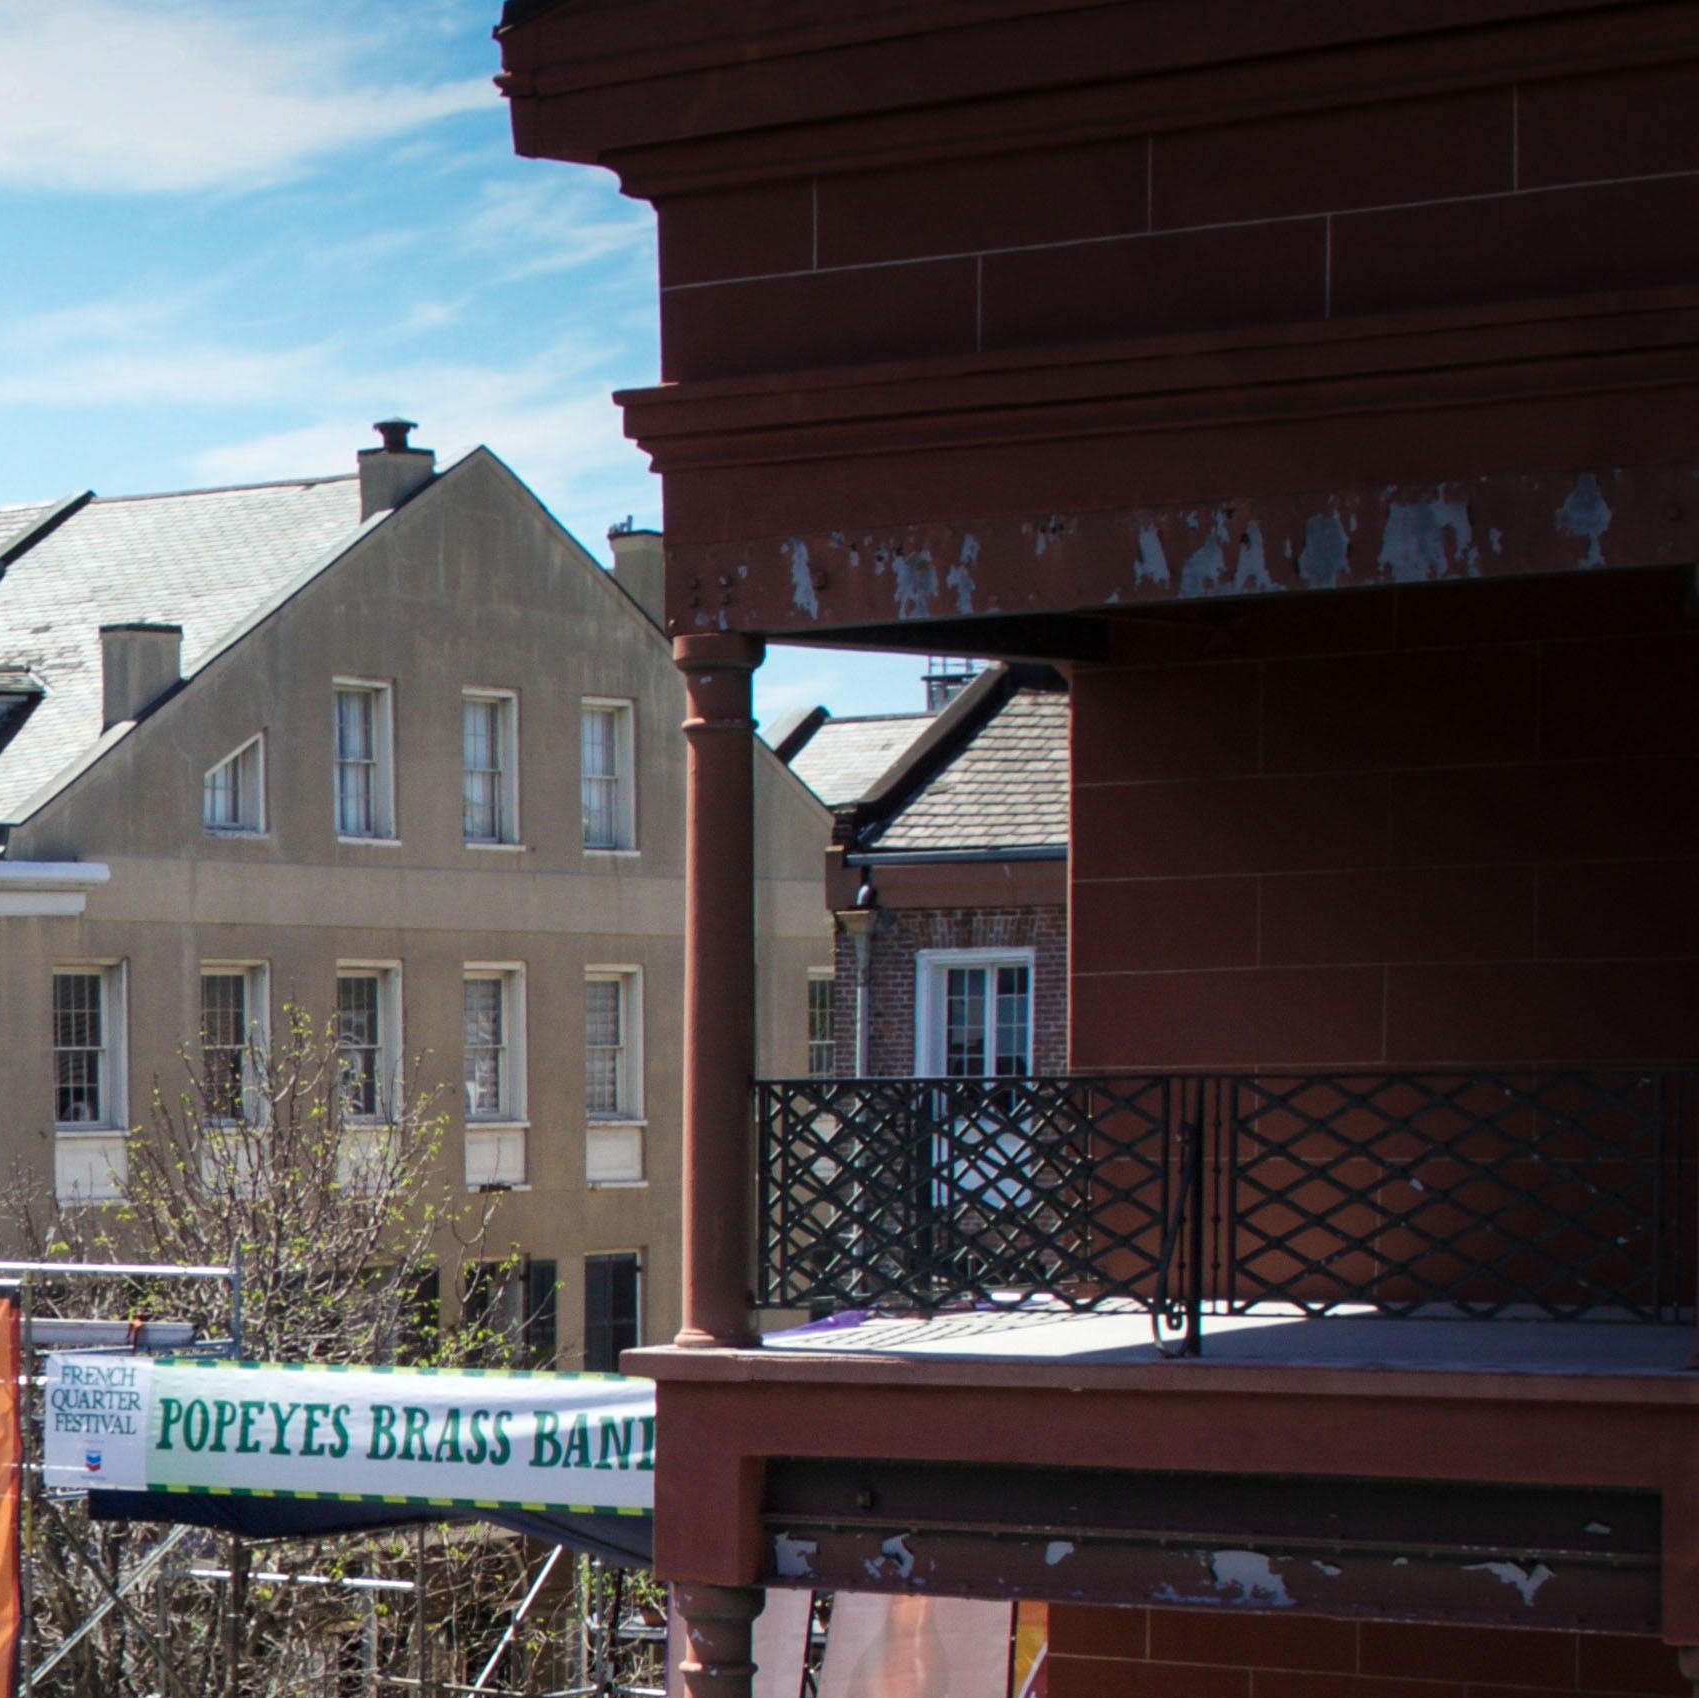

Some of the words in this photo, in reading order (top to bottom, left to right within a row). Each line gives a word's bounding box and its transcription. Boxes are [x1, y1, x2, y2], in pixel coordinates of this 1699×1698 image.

[61, 1366, 137, 1387] FRENCH
[52, 1389, 141, 1411] QUARTER
[55, 1413, 137, 1435] FESTIVAL
[155, 1397, 351, 1459] POPEYES
[366, 1404, 513, 1465] BRASS
